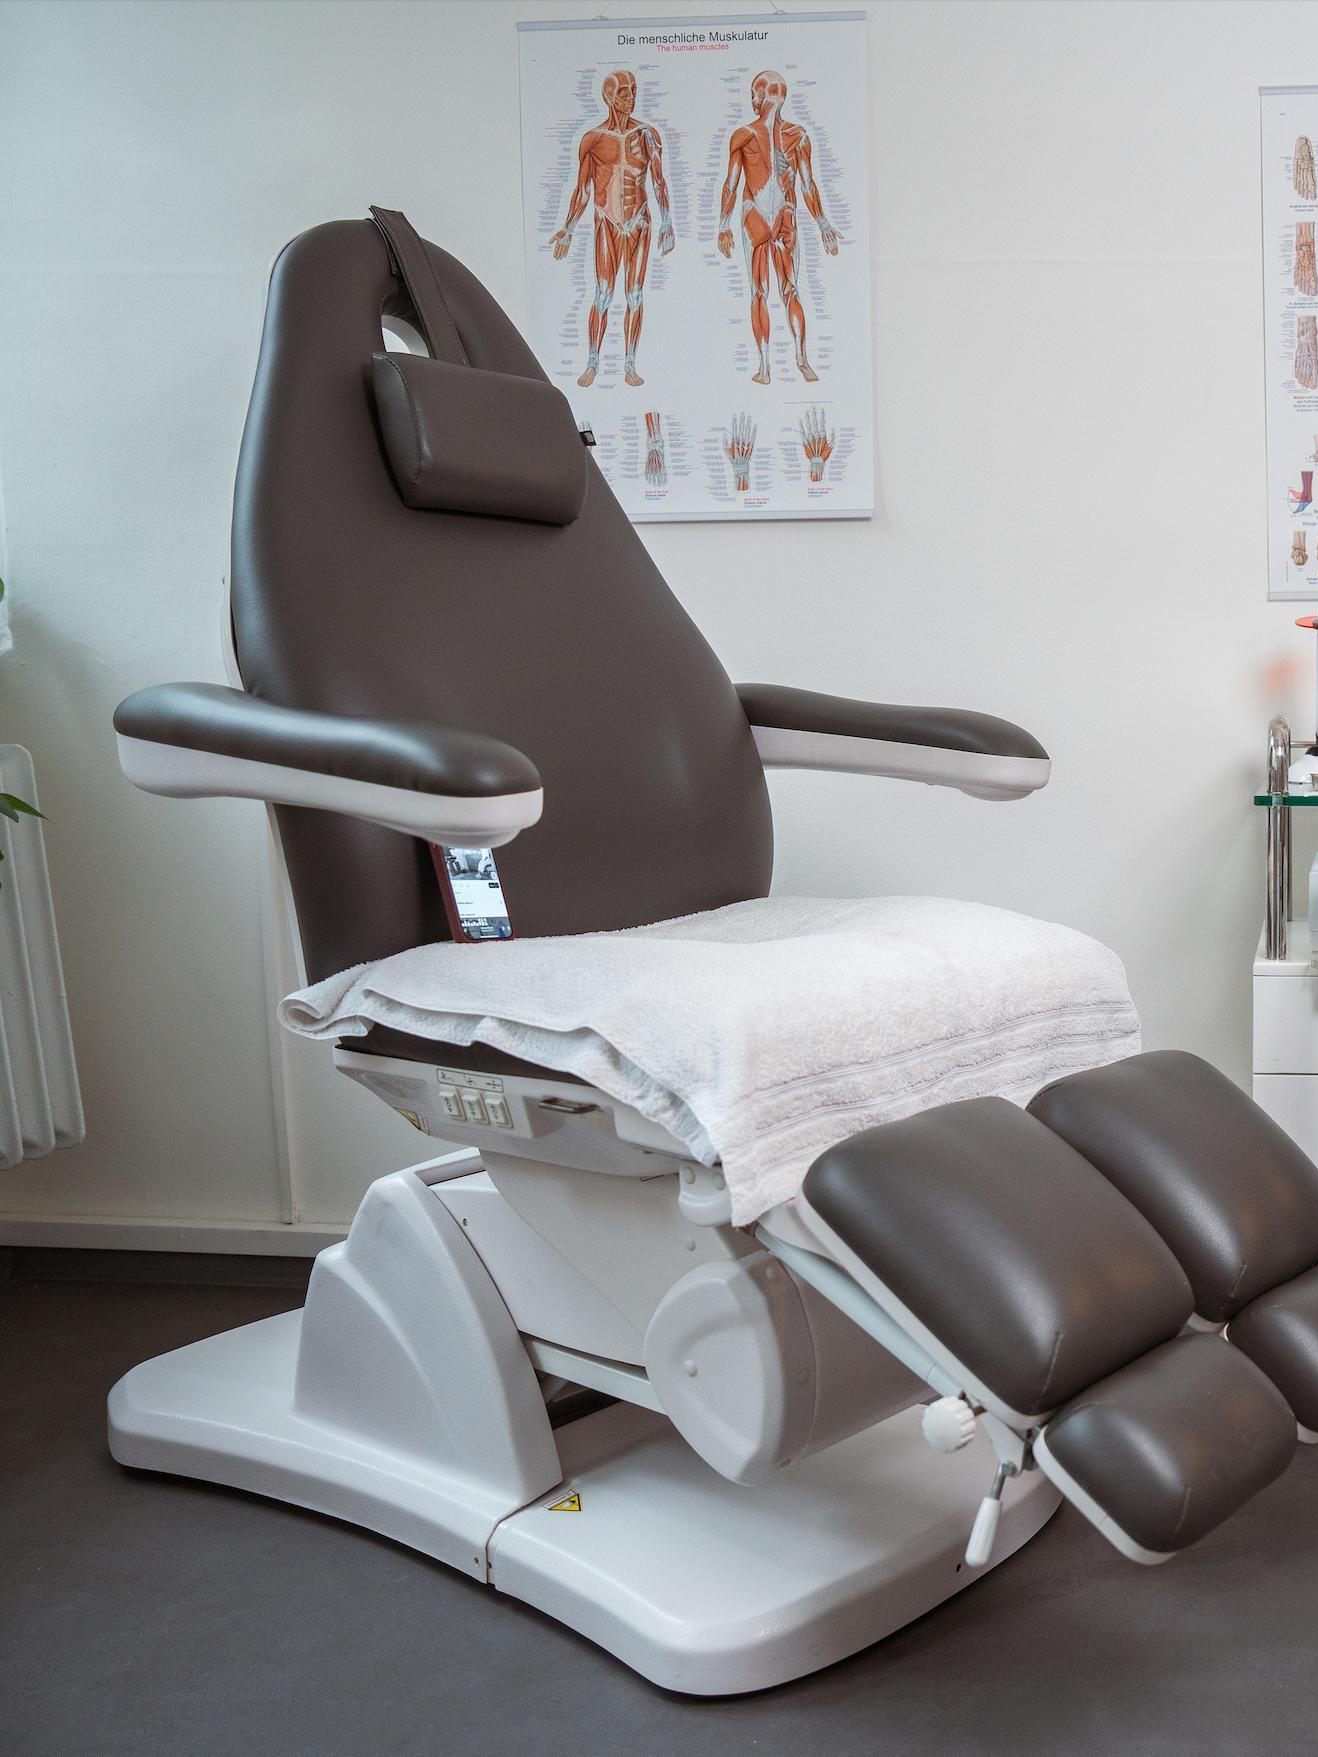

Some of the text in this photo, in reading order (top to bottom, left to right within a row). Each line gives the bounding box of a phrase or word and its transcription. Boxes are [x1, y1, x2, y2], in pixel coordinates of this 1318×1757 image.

[617, 30, 769, 46] Die menschliche Muskulatur
[656, 44, 670, 52] The
